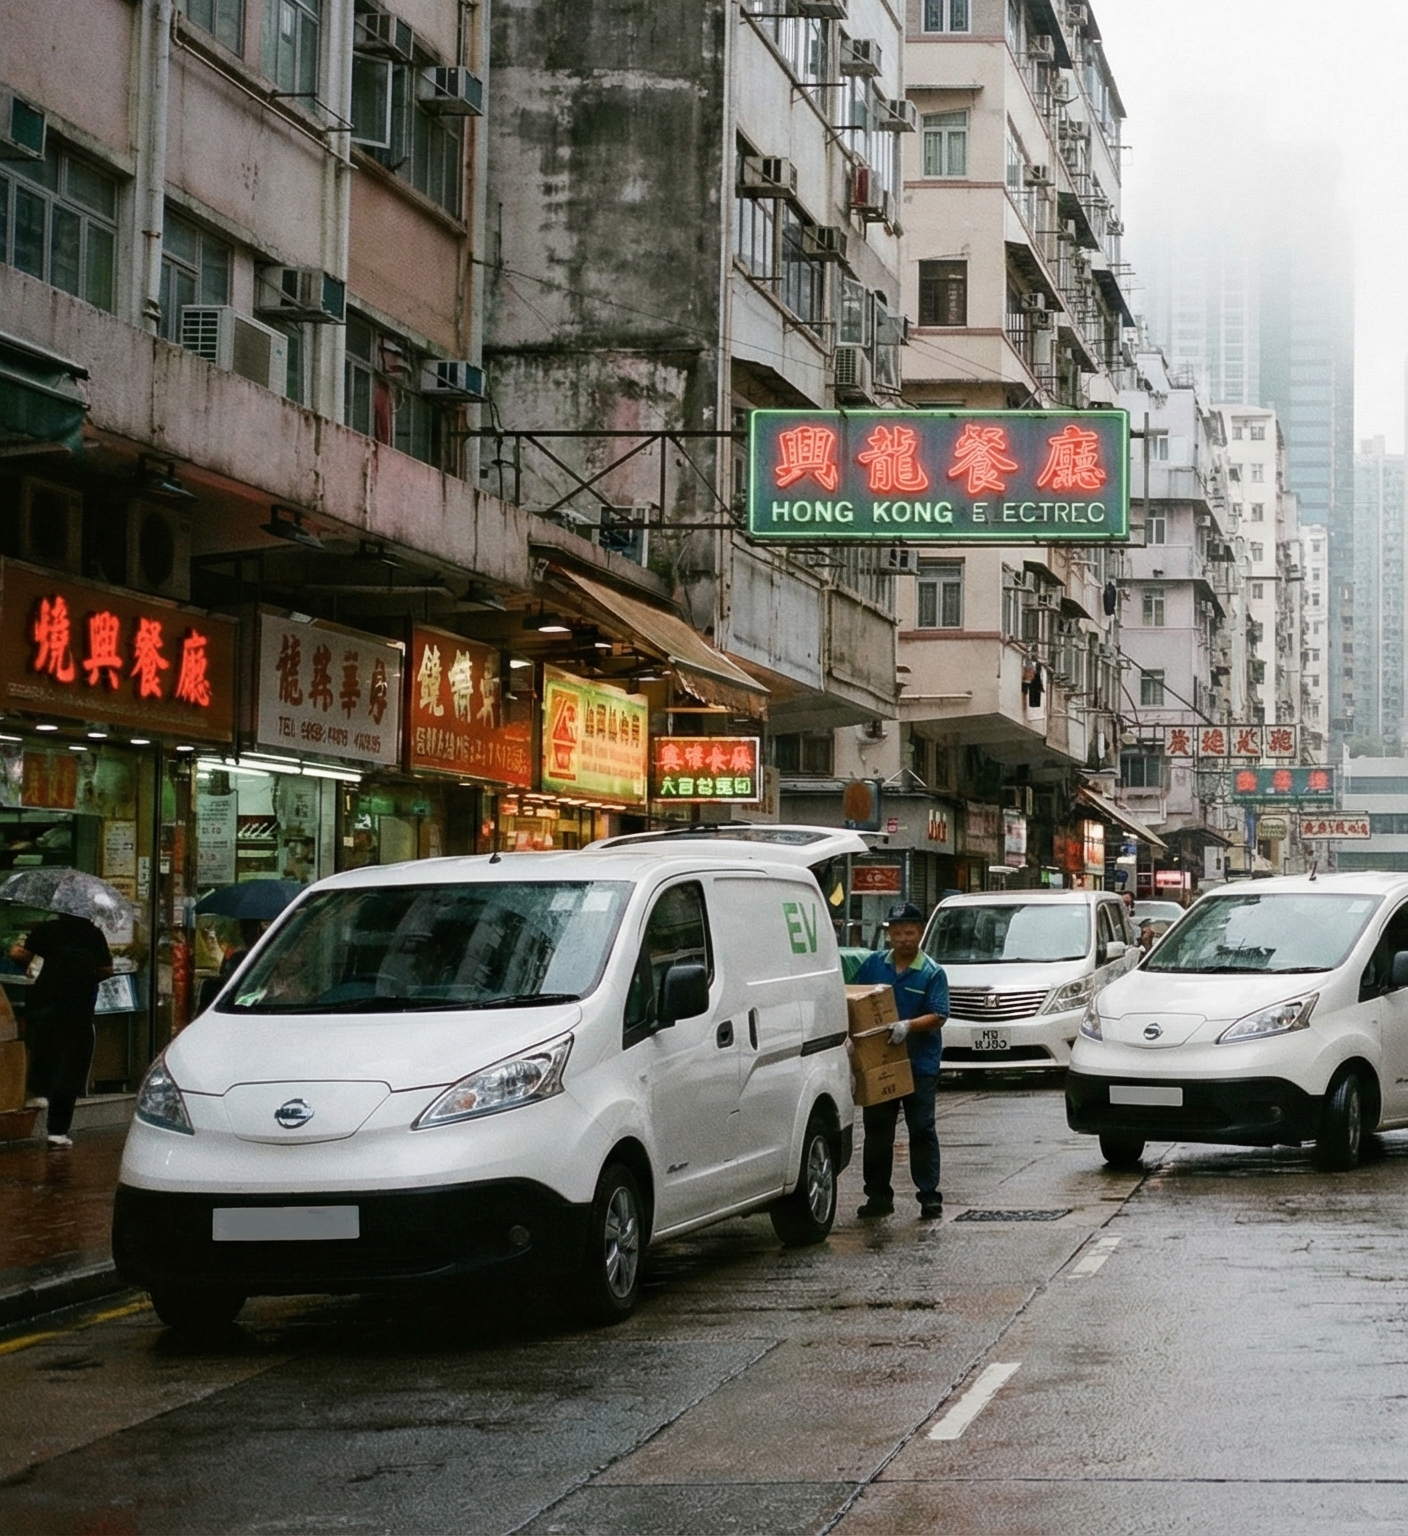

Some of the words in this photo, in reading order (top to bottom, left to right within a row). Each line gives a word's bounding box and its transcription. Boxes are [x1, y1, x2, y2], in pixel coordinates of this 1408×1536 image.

[775, 424, 1106, 494] 興龍餐廳
[772, 501, 854, 522] HONG
[873, 501, 953, 522] KONG
[783, 902, 818, 954] EV
